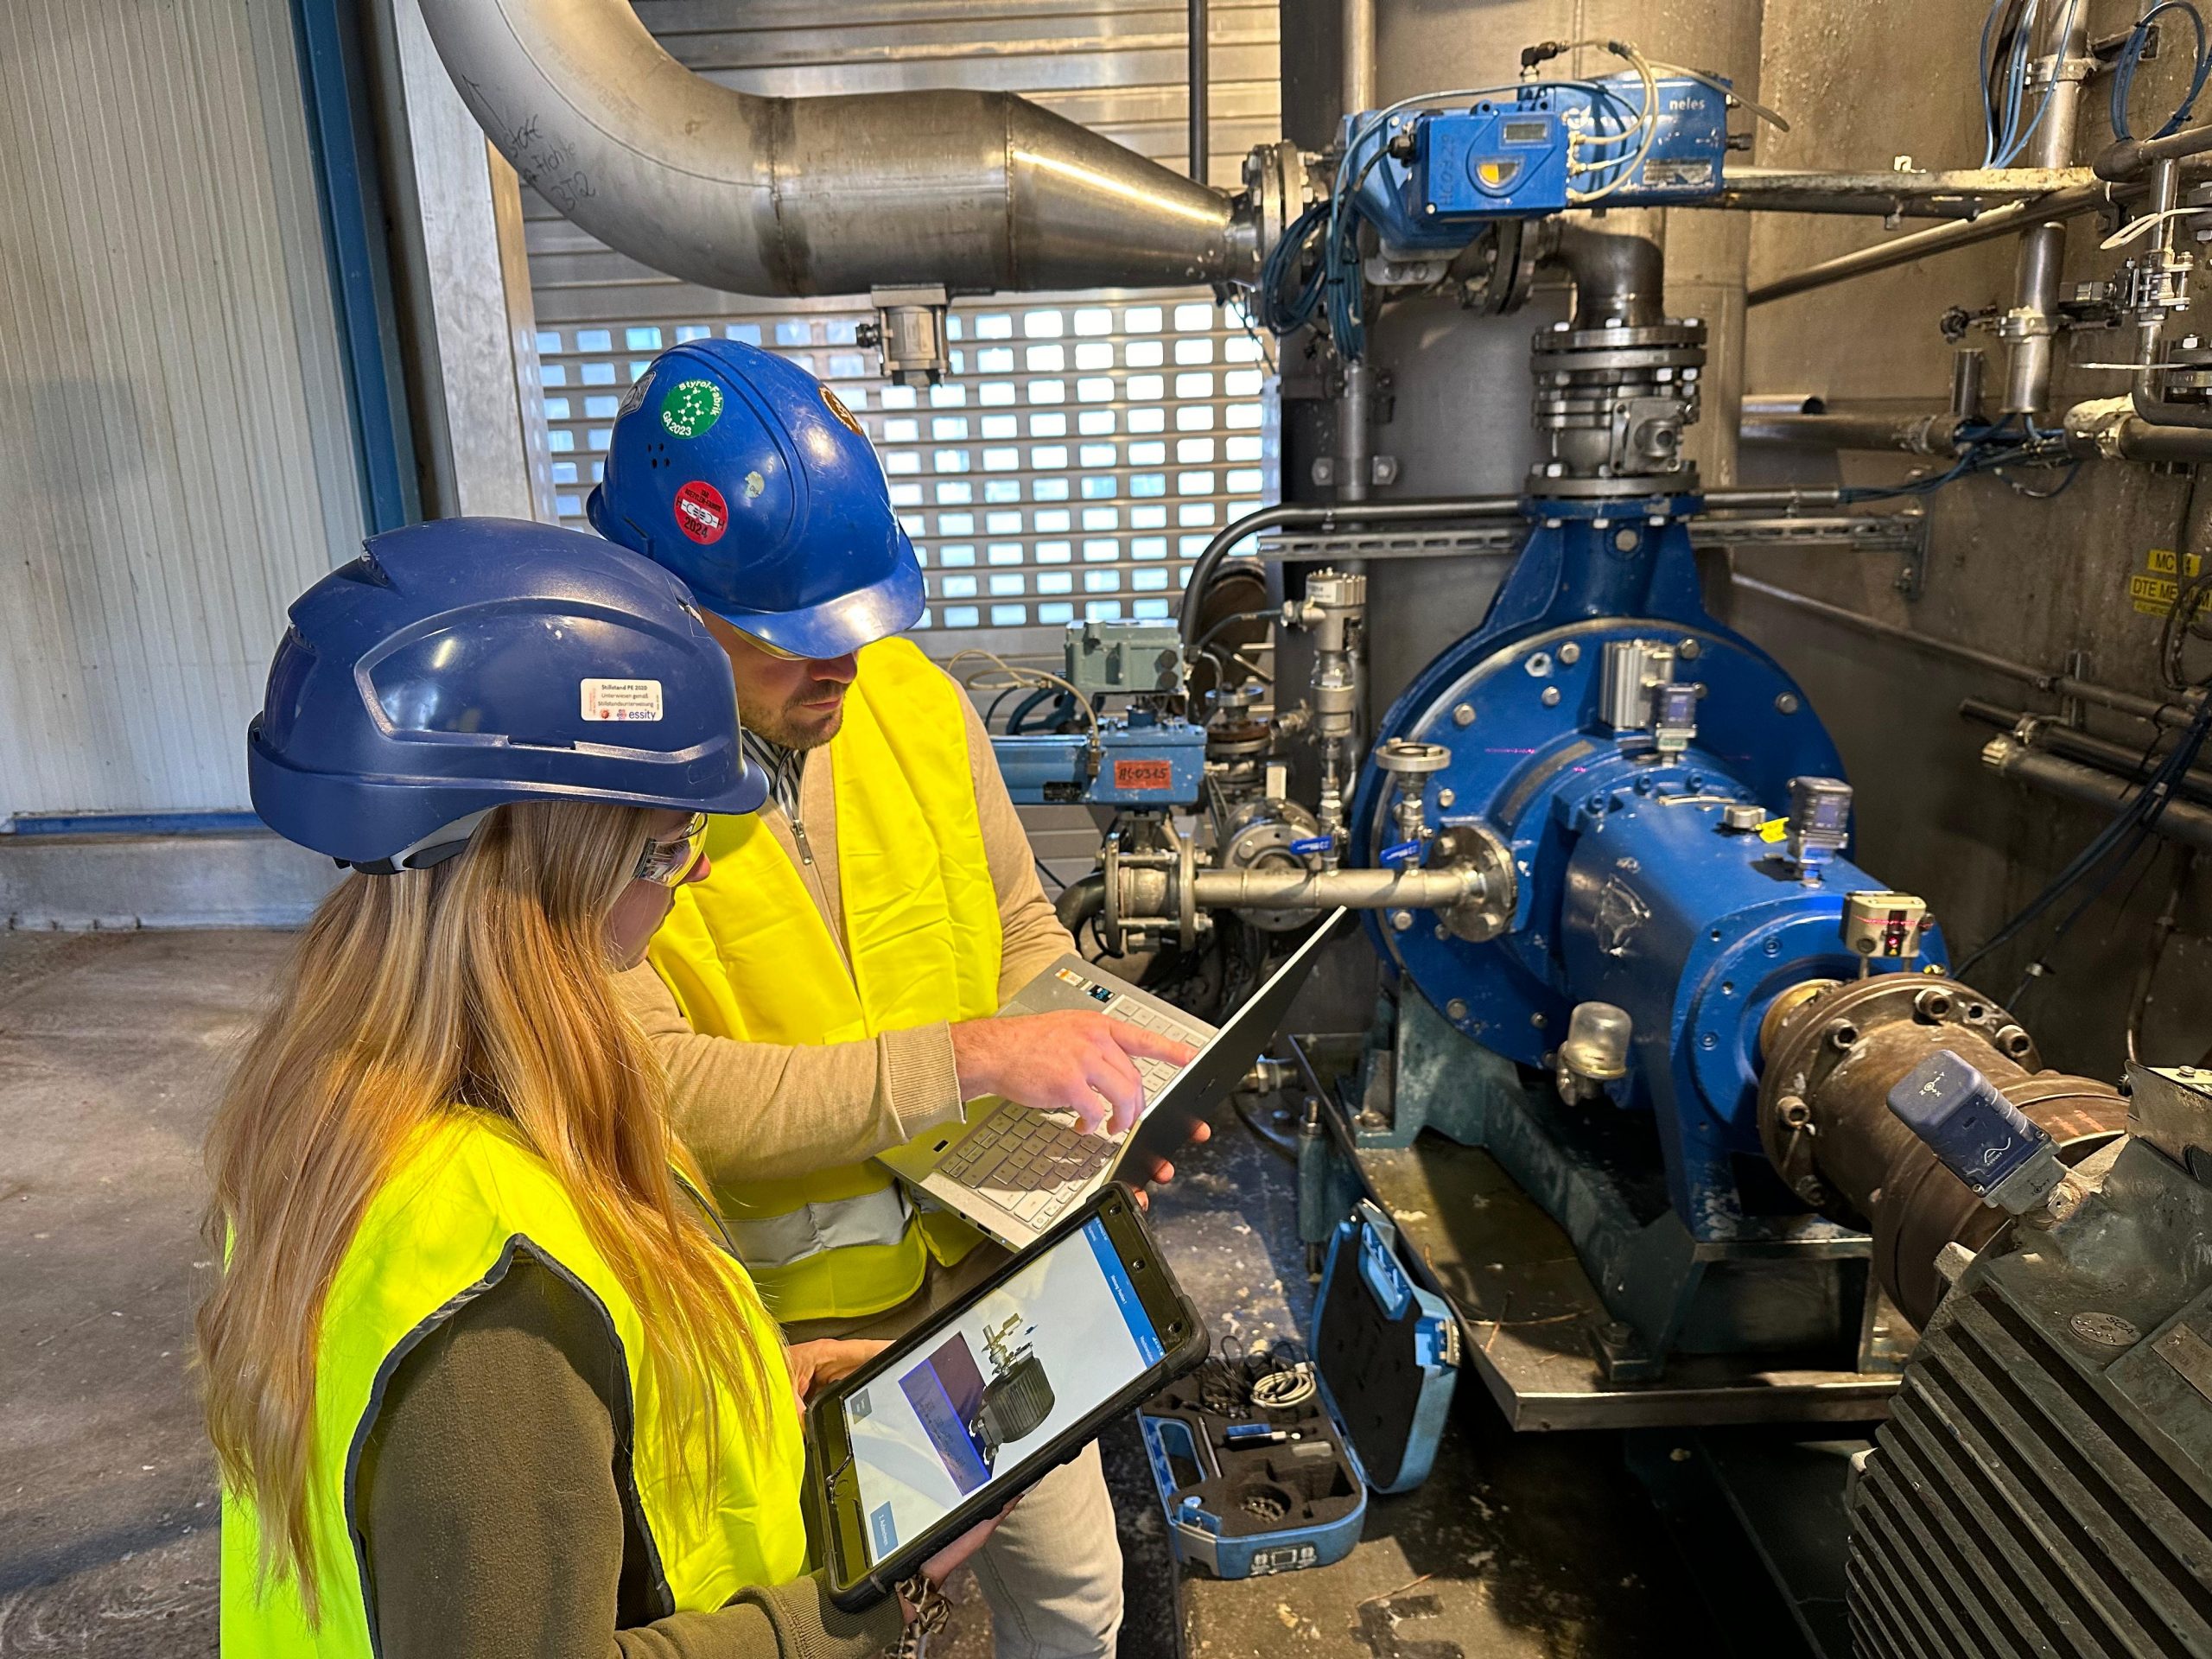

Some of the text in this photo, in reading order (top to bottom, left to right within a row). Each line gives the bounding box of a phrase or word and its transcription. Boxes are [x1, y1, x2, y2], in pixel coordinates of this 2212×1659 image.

[1669, 97, 1705, 111] neles
[678, 380, 723, 416] Styrol-Fabrik
[669, 422, 692, 436] 2023
[684, 517, 709, 537] 2024
[628, 709, 657, 721] essity
